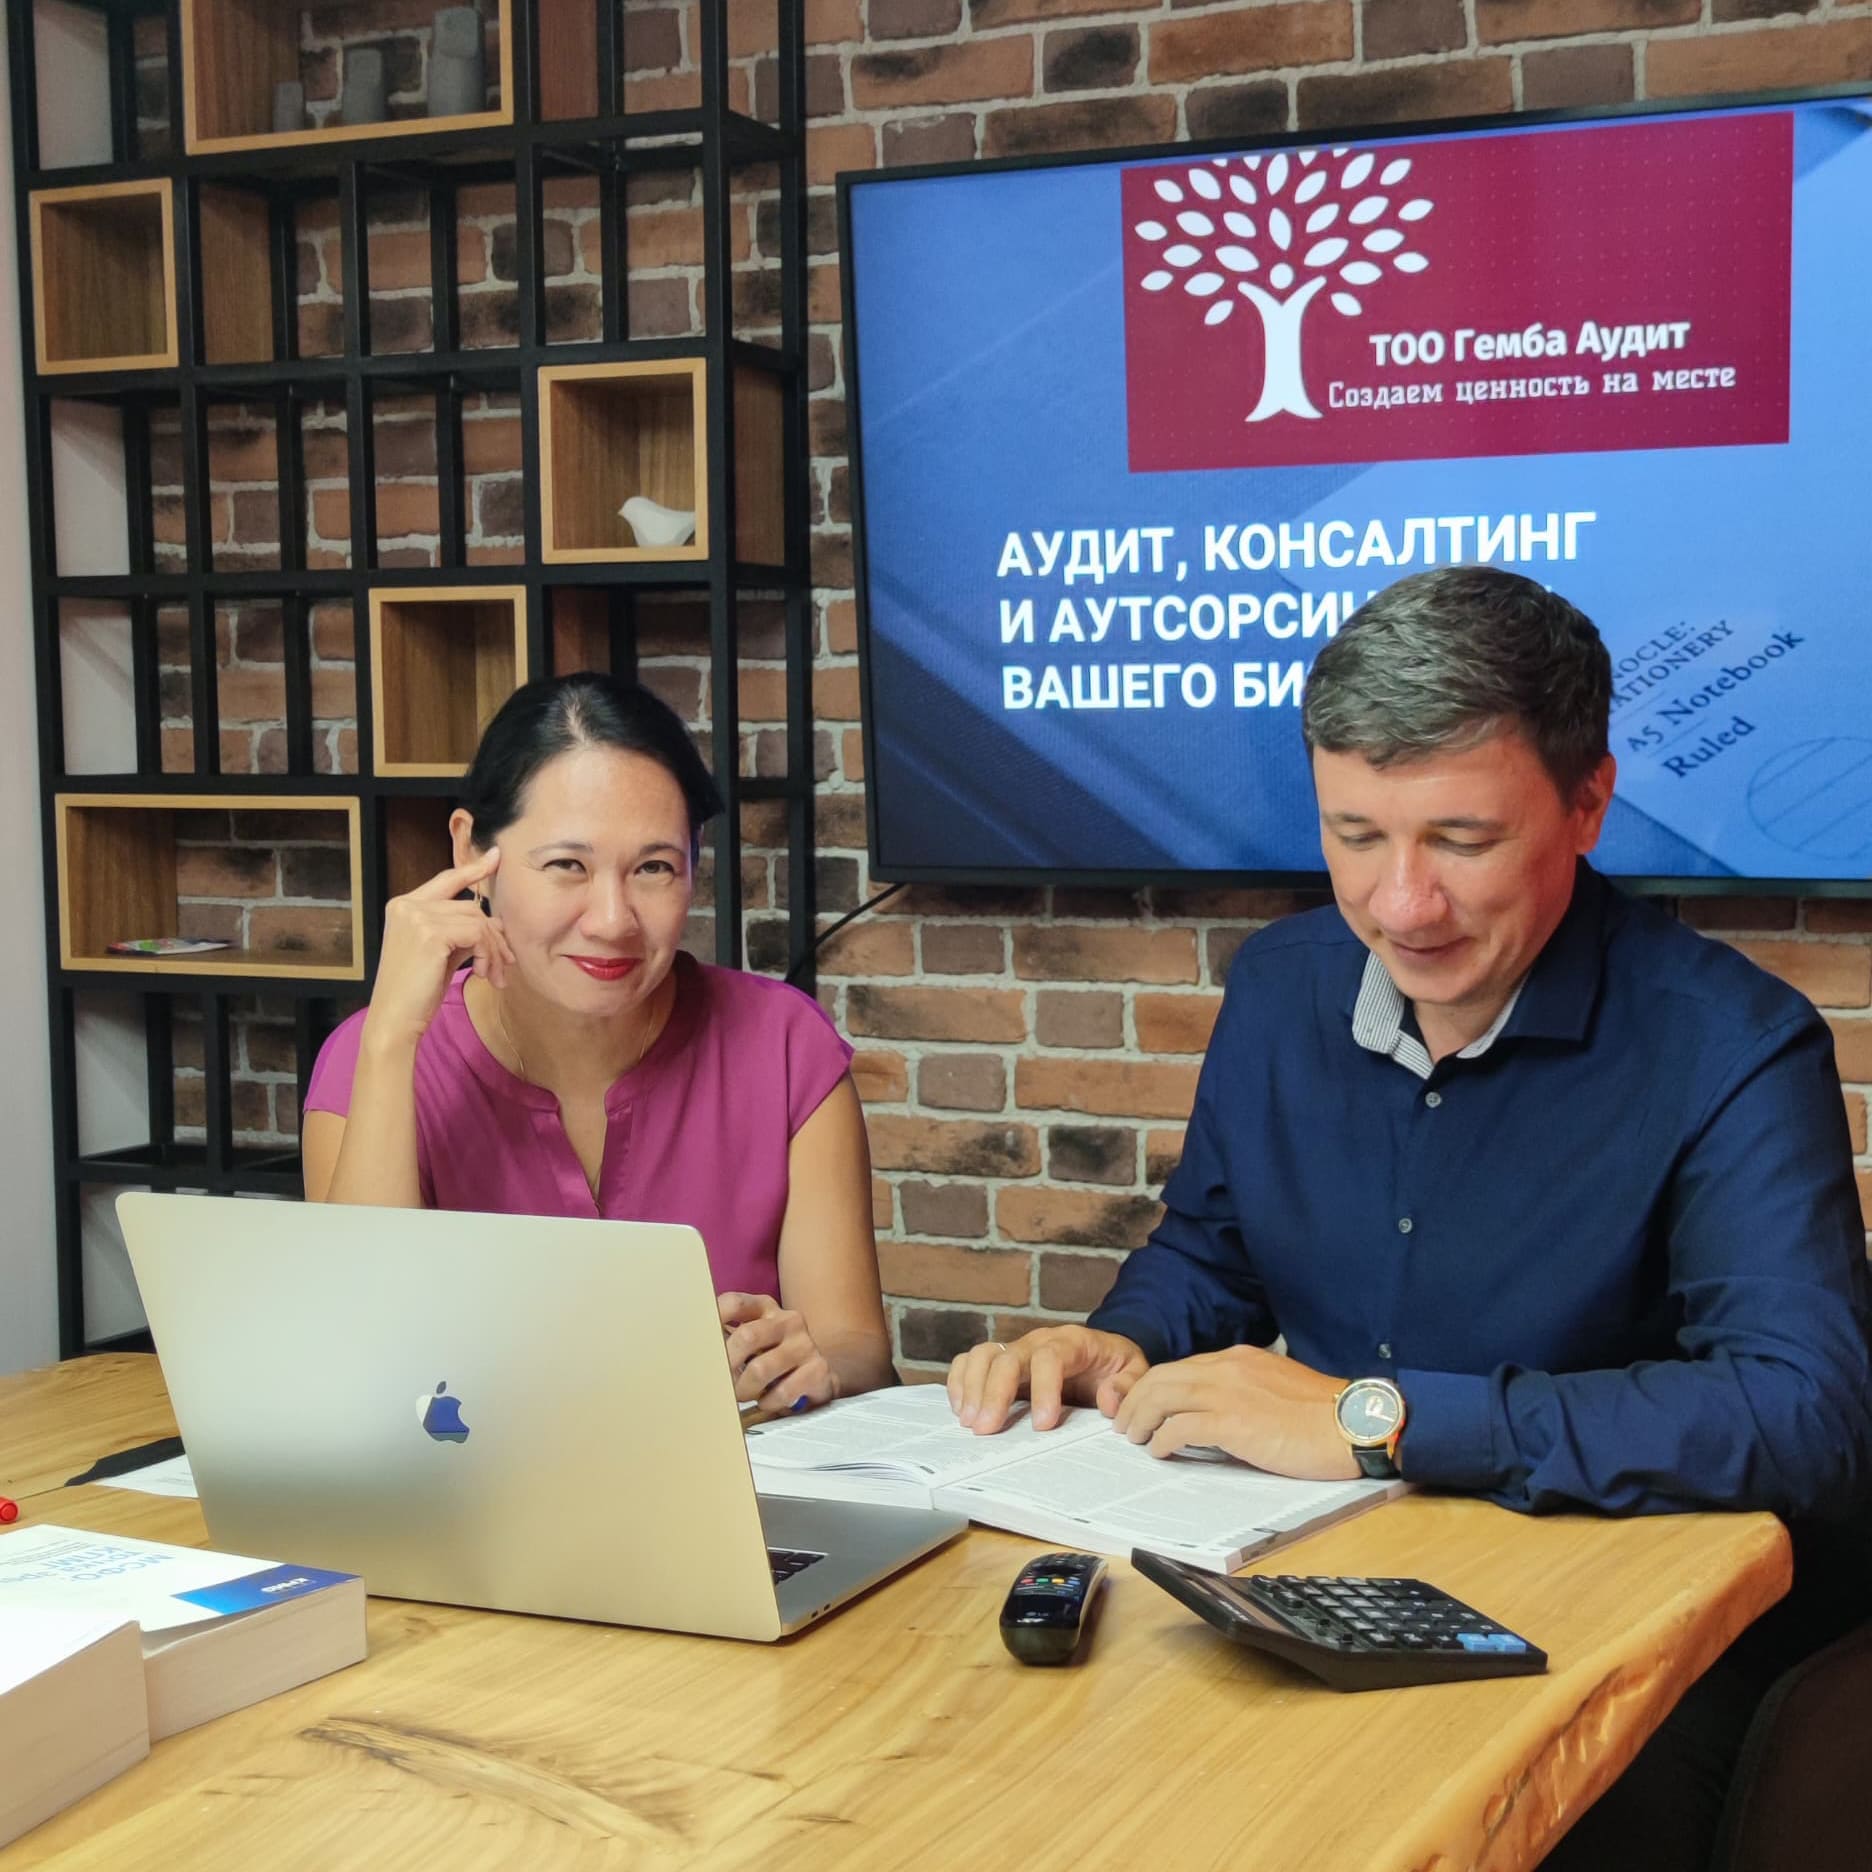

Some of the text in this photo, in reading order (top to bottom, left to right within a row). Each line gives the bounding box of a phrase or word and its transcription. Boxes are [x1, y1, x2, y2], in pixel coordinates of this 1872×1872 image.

[1368, 321, 1691, 366] ТОО Гемба Аудит
[1328, 367, 1737, 410] Создаем ценность на месте
[997, 511, 1597, 586] АУДИТ, КОНСАЛТИНГ
[1000, 599, 1034, 644] И
[1613, 621, 1696, 680] OCLE:
[1002, 660, 1305, 709] ВАШЕГО БИ
[1656, 631, 1805, 726] Notebook
[1661, 715, 1757, 779] Ruled
